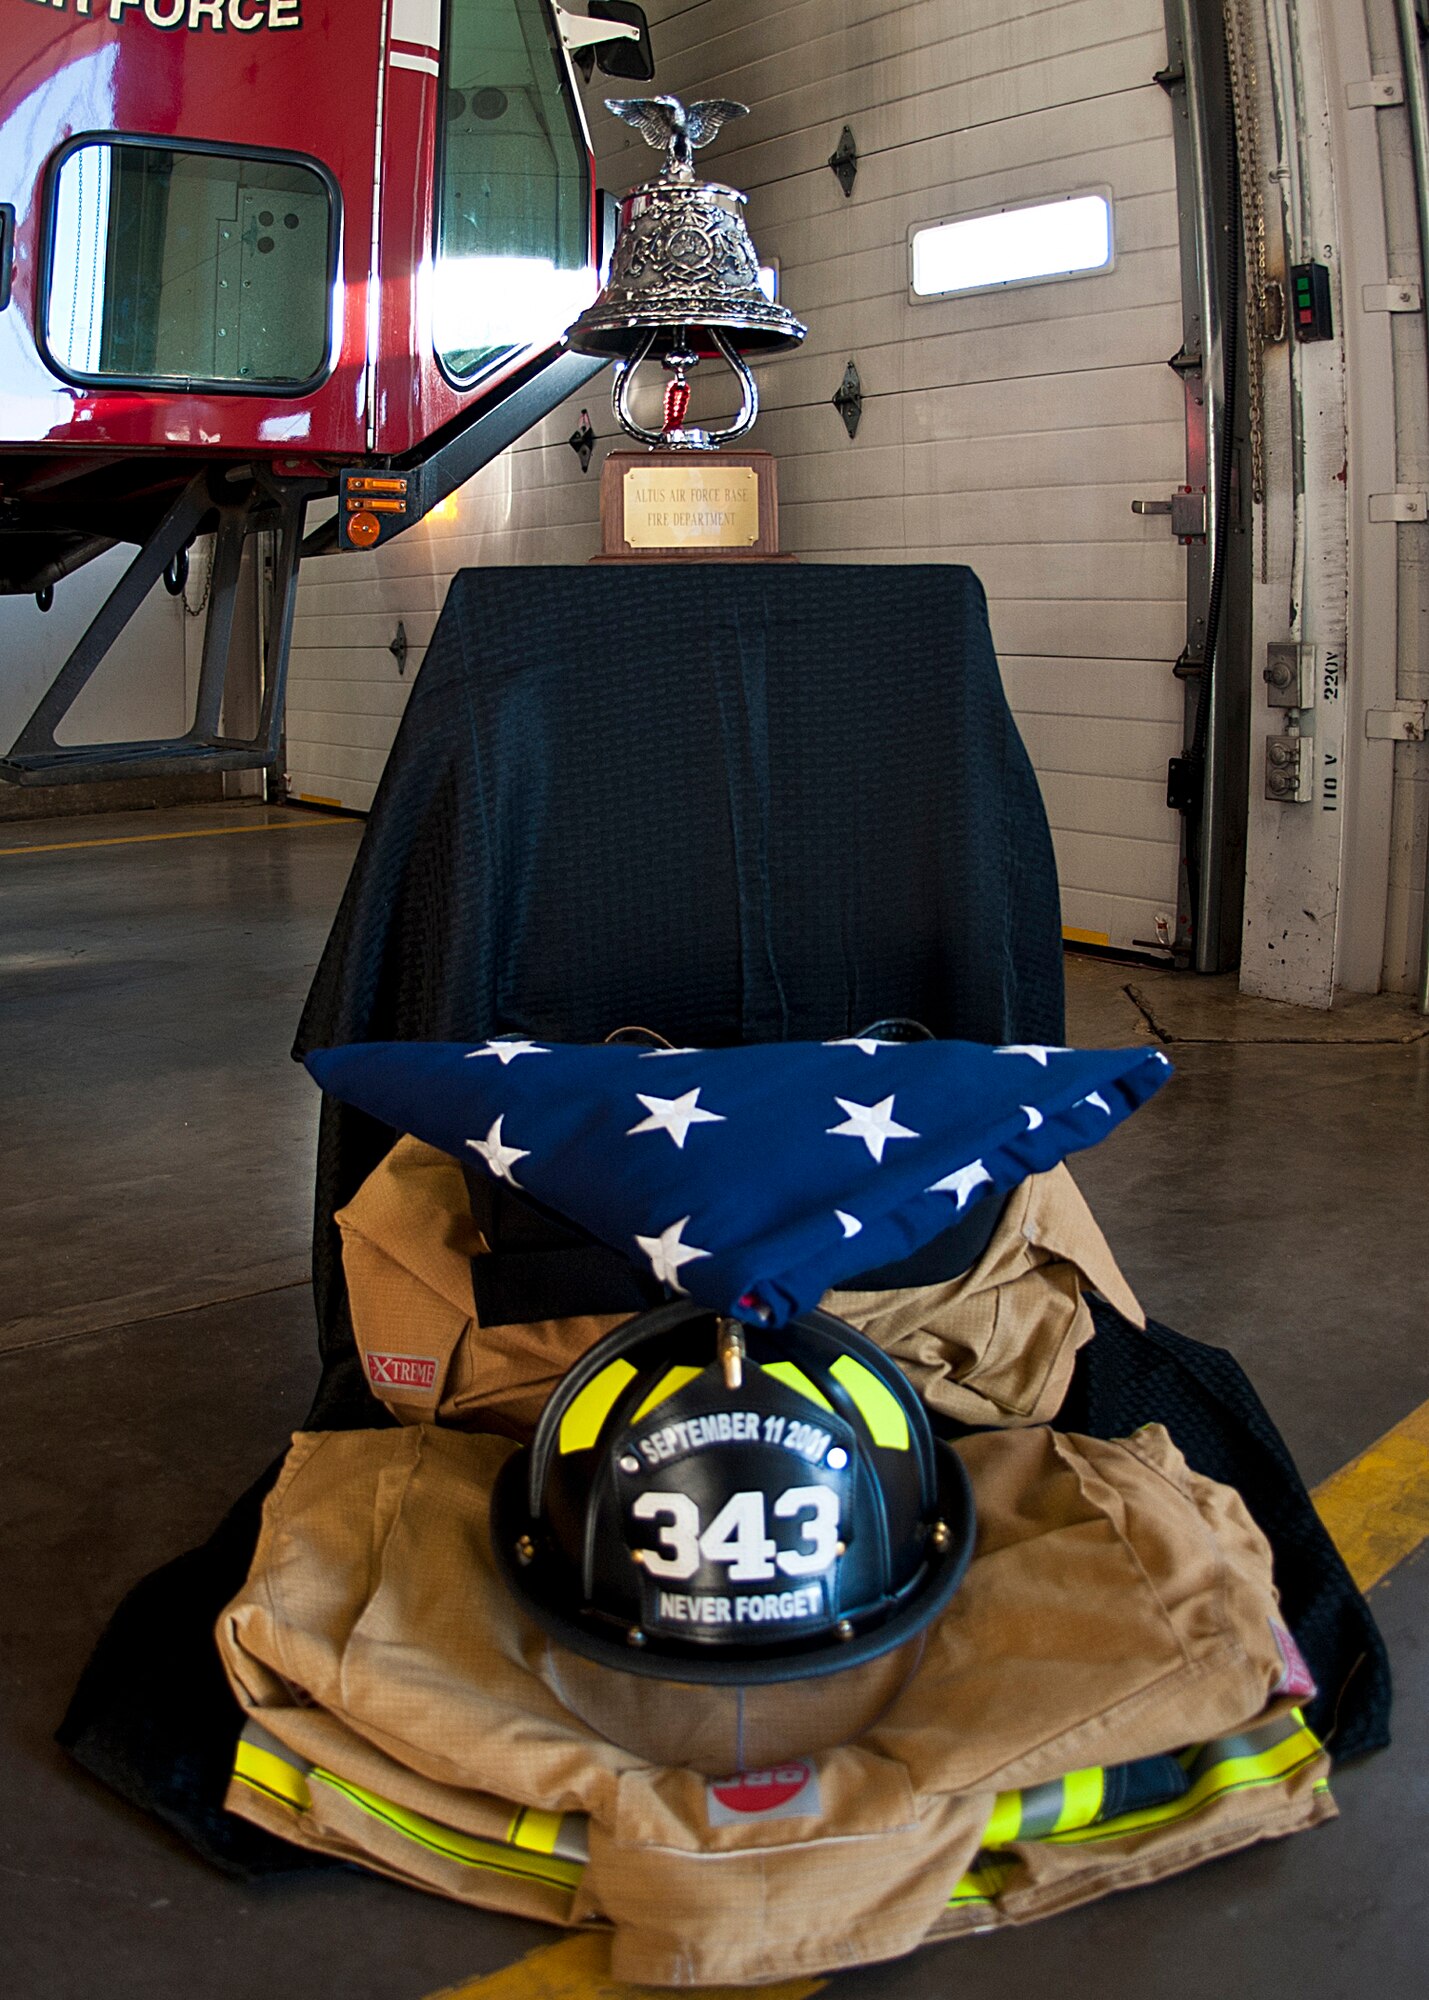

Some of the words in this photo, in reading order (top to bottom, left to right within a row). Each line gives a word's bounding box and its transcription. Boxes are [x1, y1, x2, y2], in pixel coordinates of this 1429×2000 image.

[1323, 244, 1333, 259] 3
[635, 489, 665, 503] ALTUS
[670, 489, 686, 503] AIR
[690, 488, 721, 503] FORCE
[724, 488, 748, 502] BASE
[647, 513, 669, 526] FIRE
[673, 512, 736, 526] DEPARTMENT
[1324, 753, 1338, 766] V
[1322, 777, 1338, 812] 110
[638, 1412, 760, 1465] SEPTEMBER
[763, 1415, 785, 1443] 11
[783, 1420, 832, 1464] 2001
[632, 1485, 841, 1581] 343
[659, 1592, 731, 1622] NEVER
[735, 1584, 823, 1622] FORGET
